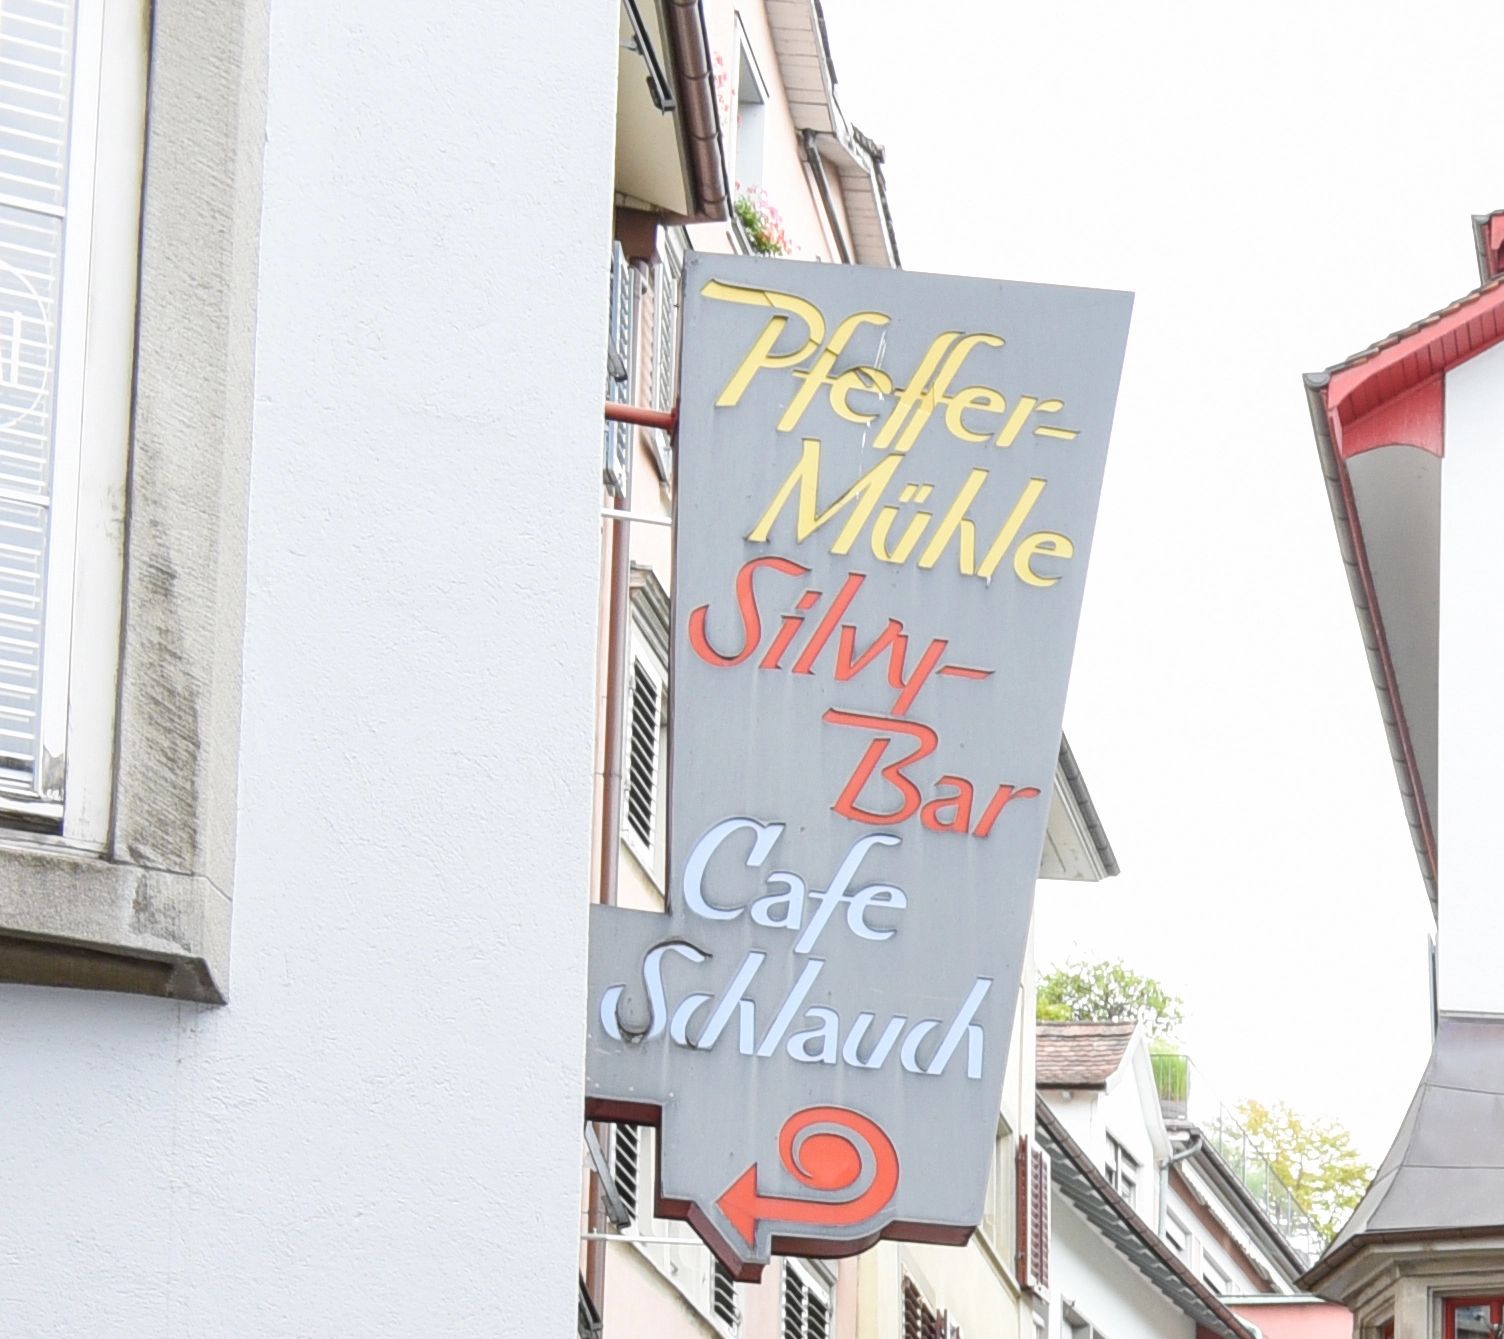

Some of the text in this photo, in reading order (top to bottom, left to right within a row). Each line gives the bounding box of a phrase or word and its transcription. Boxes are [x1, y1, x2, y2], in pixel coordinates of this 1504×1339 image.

[703, 280, 1080, 454] Pfeffer-
[747, 441, 1074, 586] Mühle
[823, 709, 1041, 838] Bar
[684, 817, 907, 953] Cafe
[602, 940, 991, 1078] Schlauch
